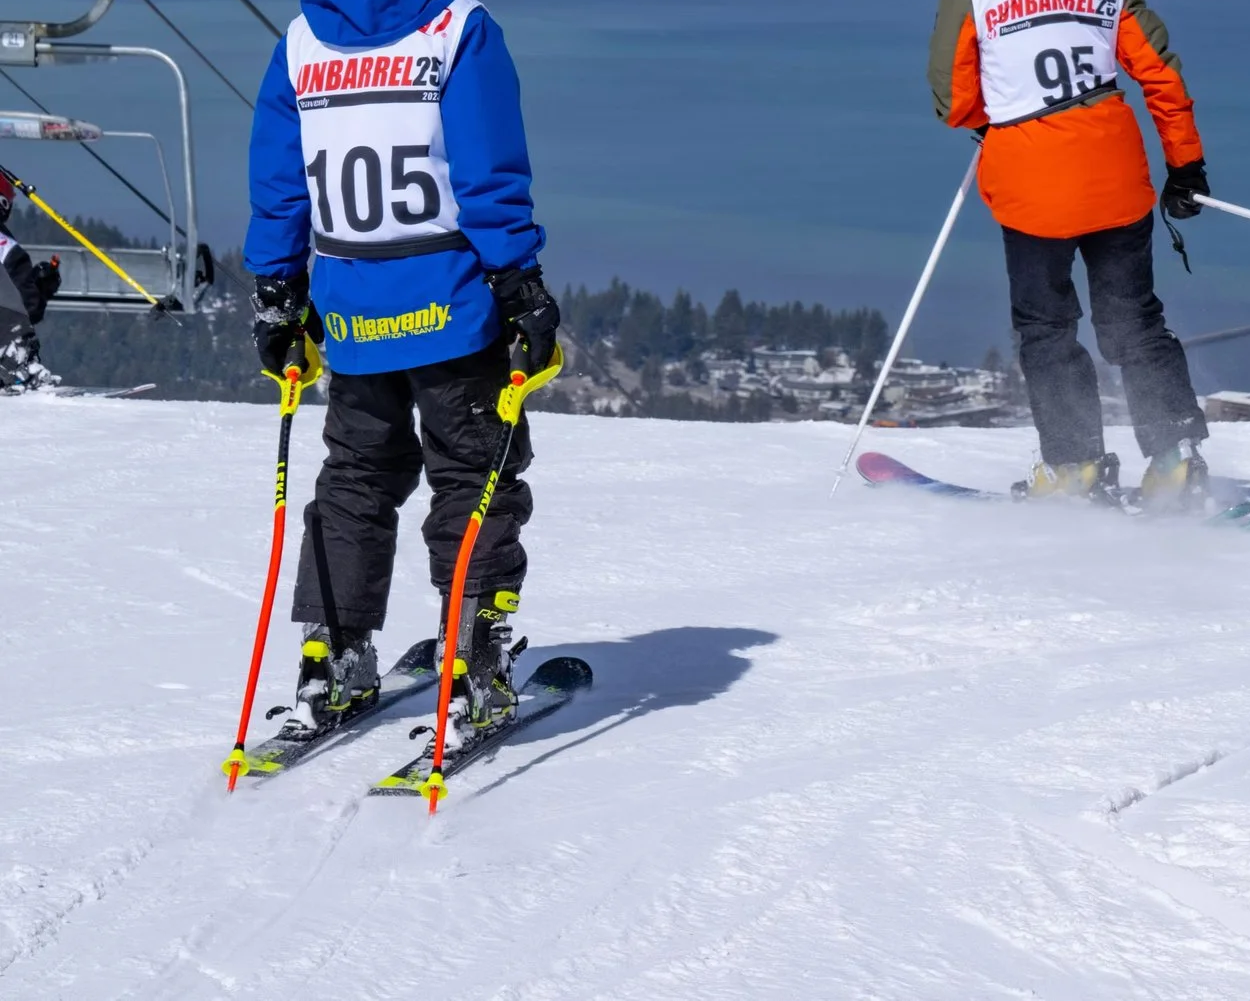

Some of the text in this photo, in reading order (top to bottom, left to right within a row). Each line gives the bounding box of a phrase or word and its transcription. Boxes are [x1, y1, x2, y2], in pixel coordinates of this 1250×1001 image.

[1034, 46, 1102, 107] 95
[422, 91, 440, 101] 202
[306, 144, 441, 234] 105
[351, 302, 451, 337] Heavenly
[354, 325, 435, 343] COMPETITION TEAM
